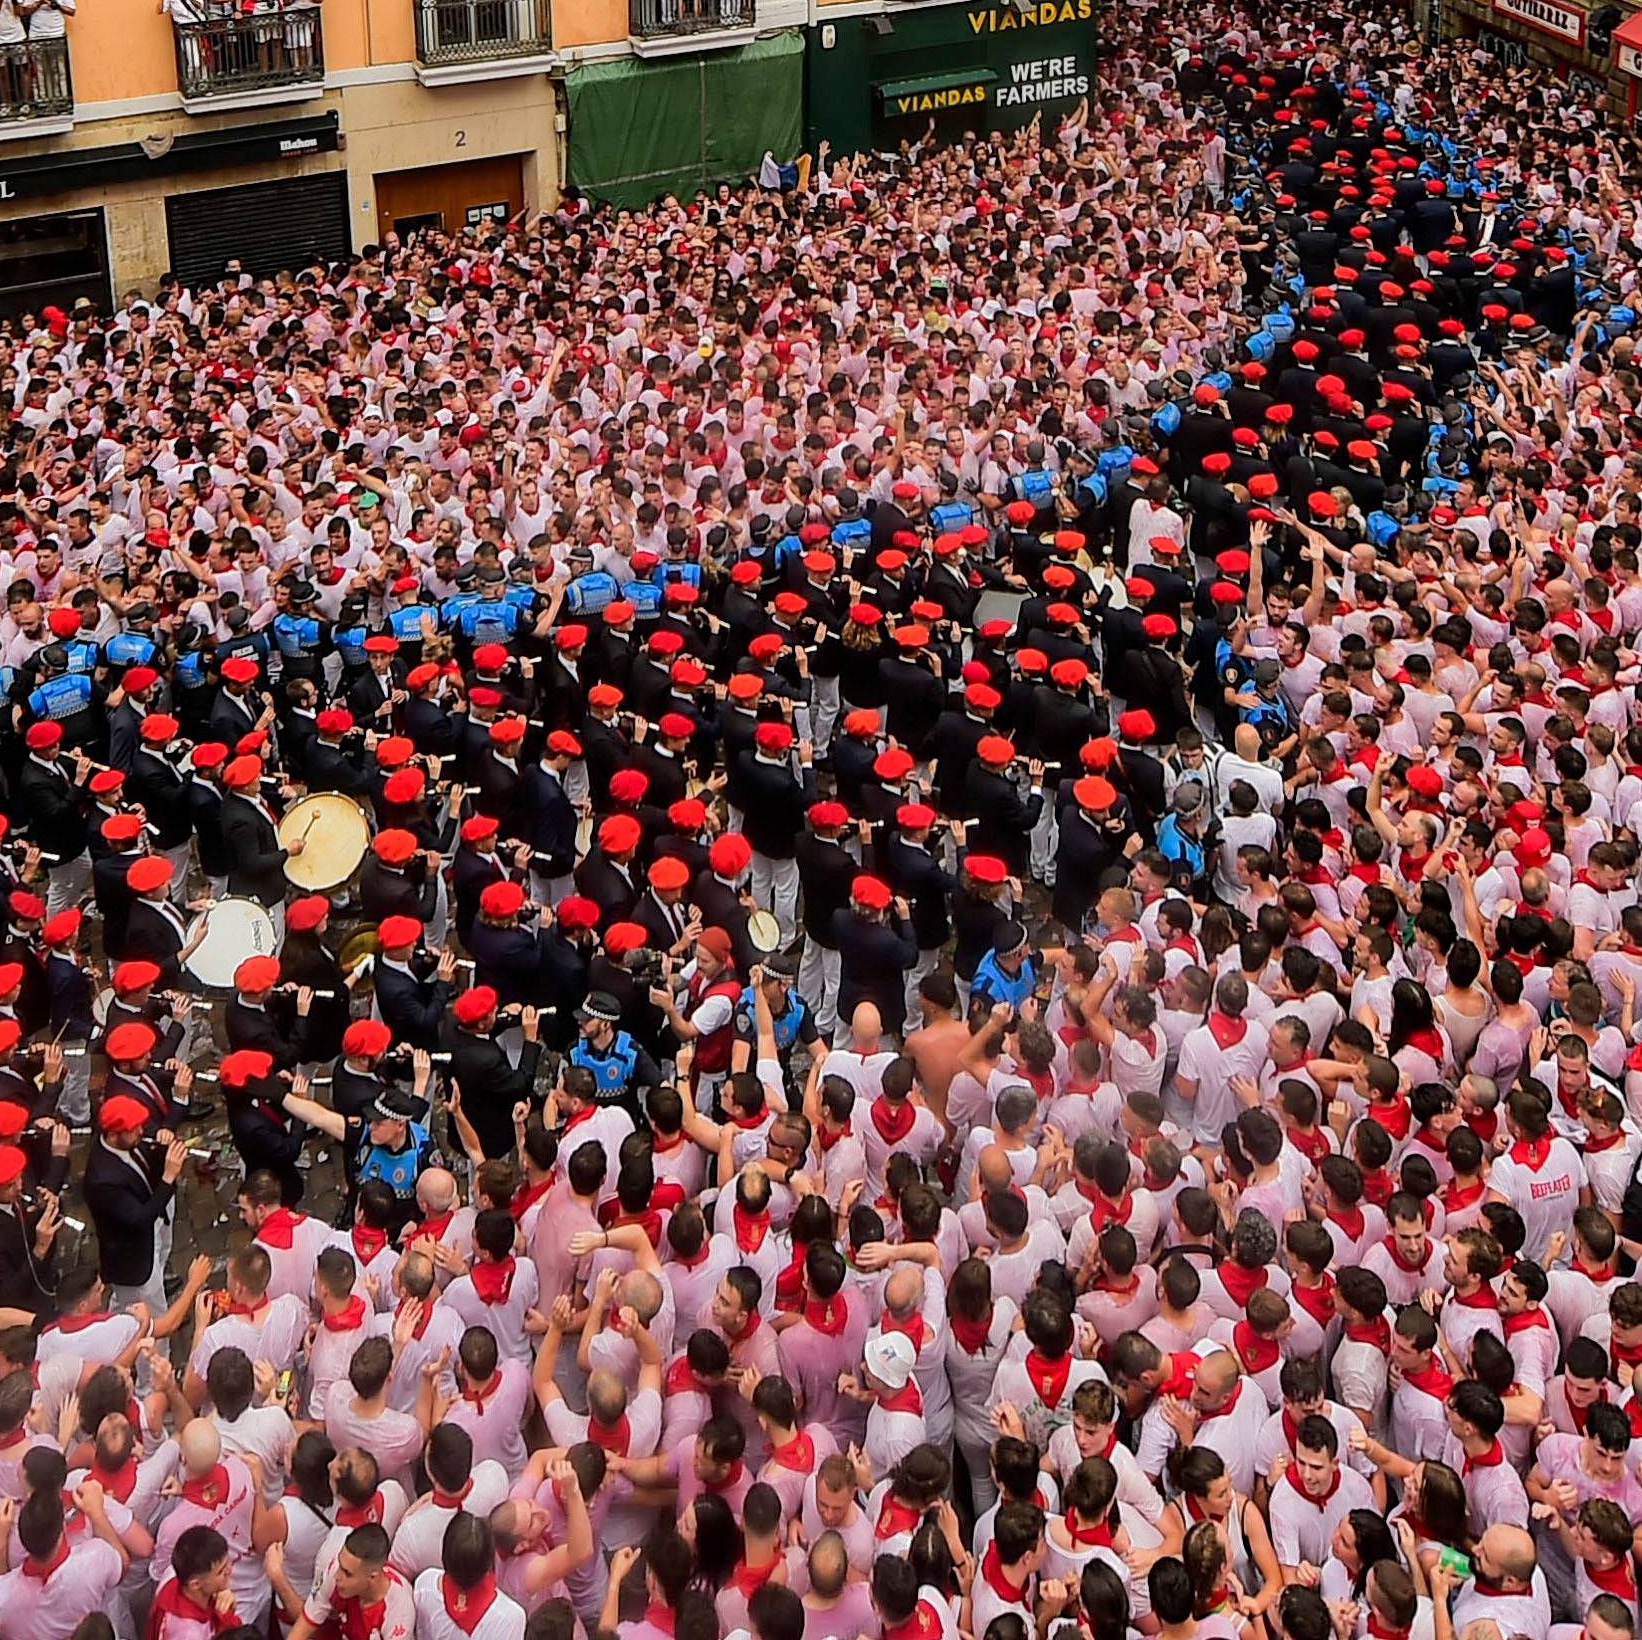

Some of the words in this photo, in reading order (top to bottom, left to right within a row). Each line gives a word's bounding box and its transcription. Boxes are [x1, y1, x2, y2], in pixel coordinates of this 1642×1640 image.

[897, 86, 987, 113] VIANDAS
[995, 75, 1090, 108] FARMERS
[455, 130, 466, 147] 2
